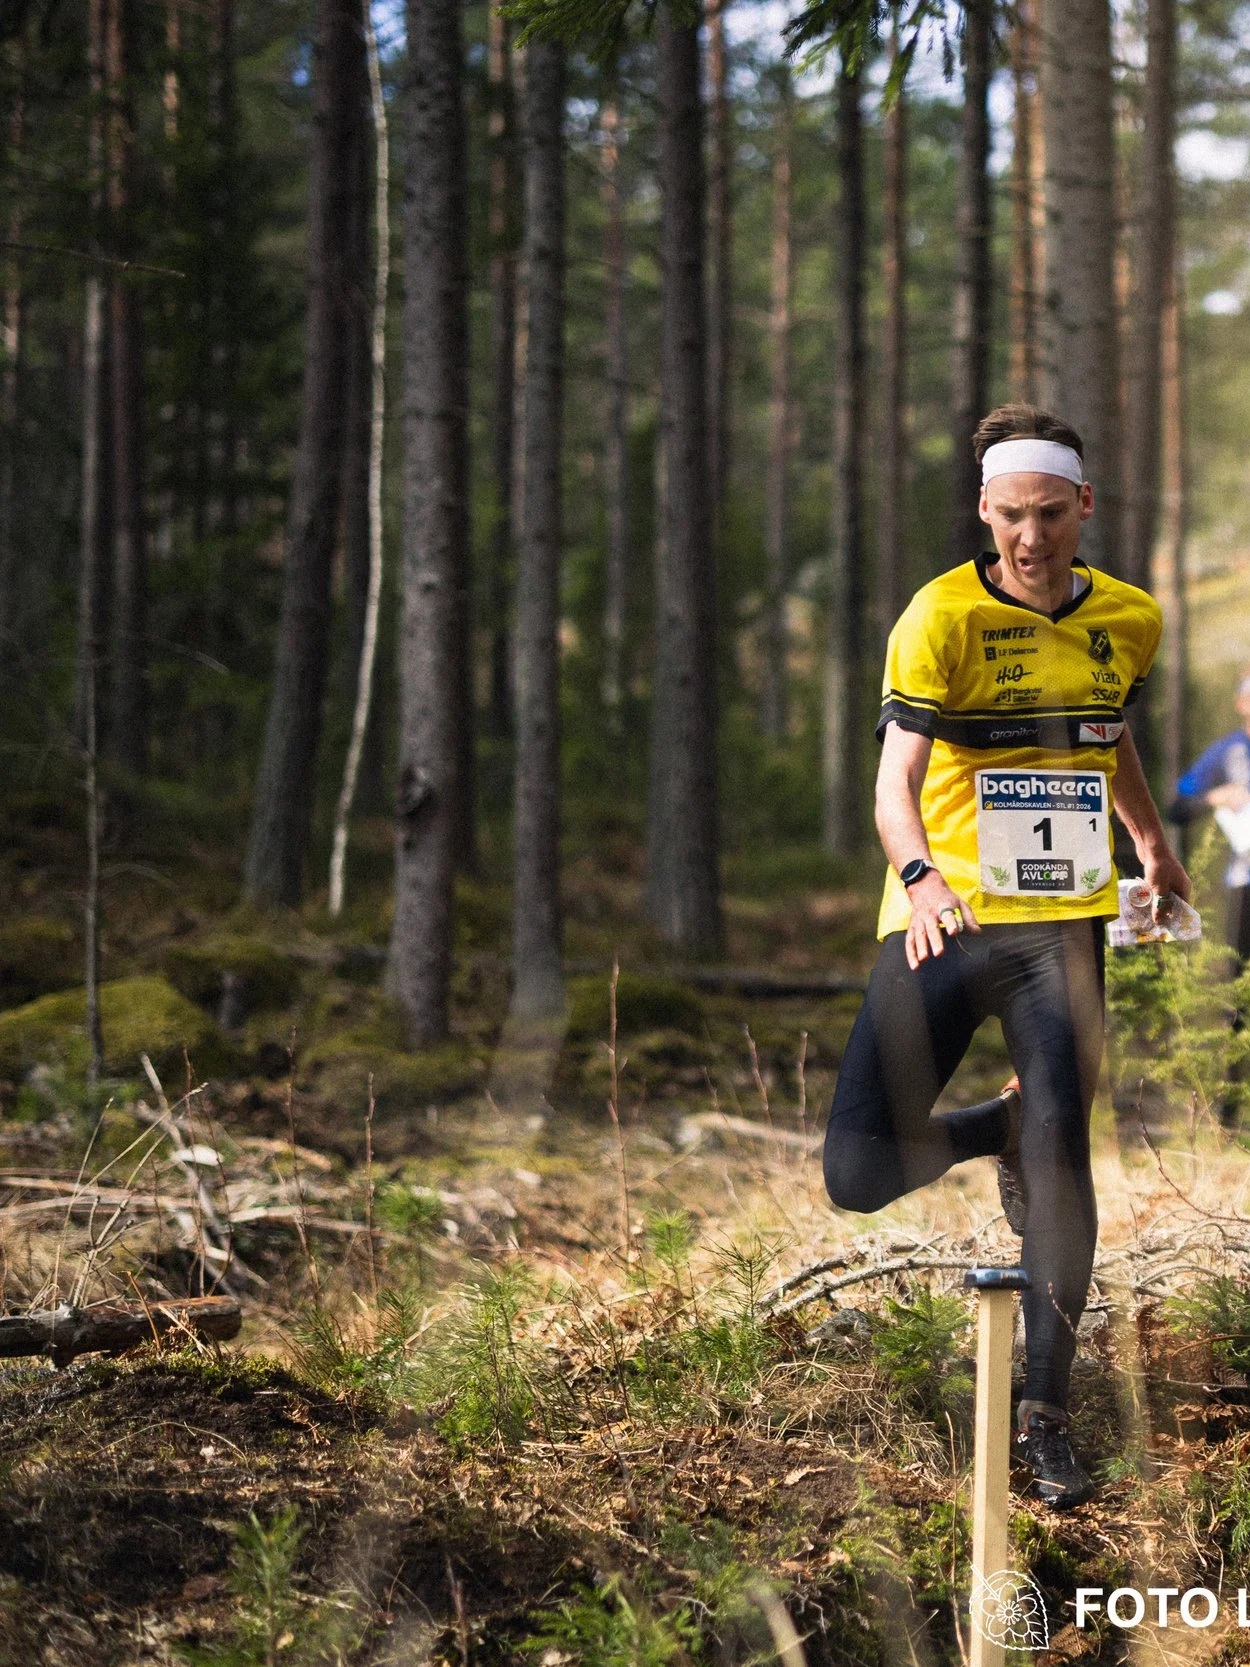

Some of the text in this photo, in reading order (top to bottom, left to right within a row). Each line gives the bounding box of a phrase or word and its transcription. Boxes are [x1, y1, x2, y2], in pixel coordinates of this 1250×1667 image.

[982, 626, 1037, 642] TRIMTEX
[995, 664, 1034, 685] HiQ
[982, 777, 1101, 799] bagheera
[993, 800, 1052, 809] KOLMÅRDSKAVLEN
[1088, 818, 1097, 832] 1
[1033, 817, 1053, 851] 1
[1021, 862, 1069, 870] GODKÄNDA
